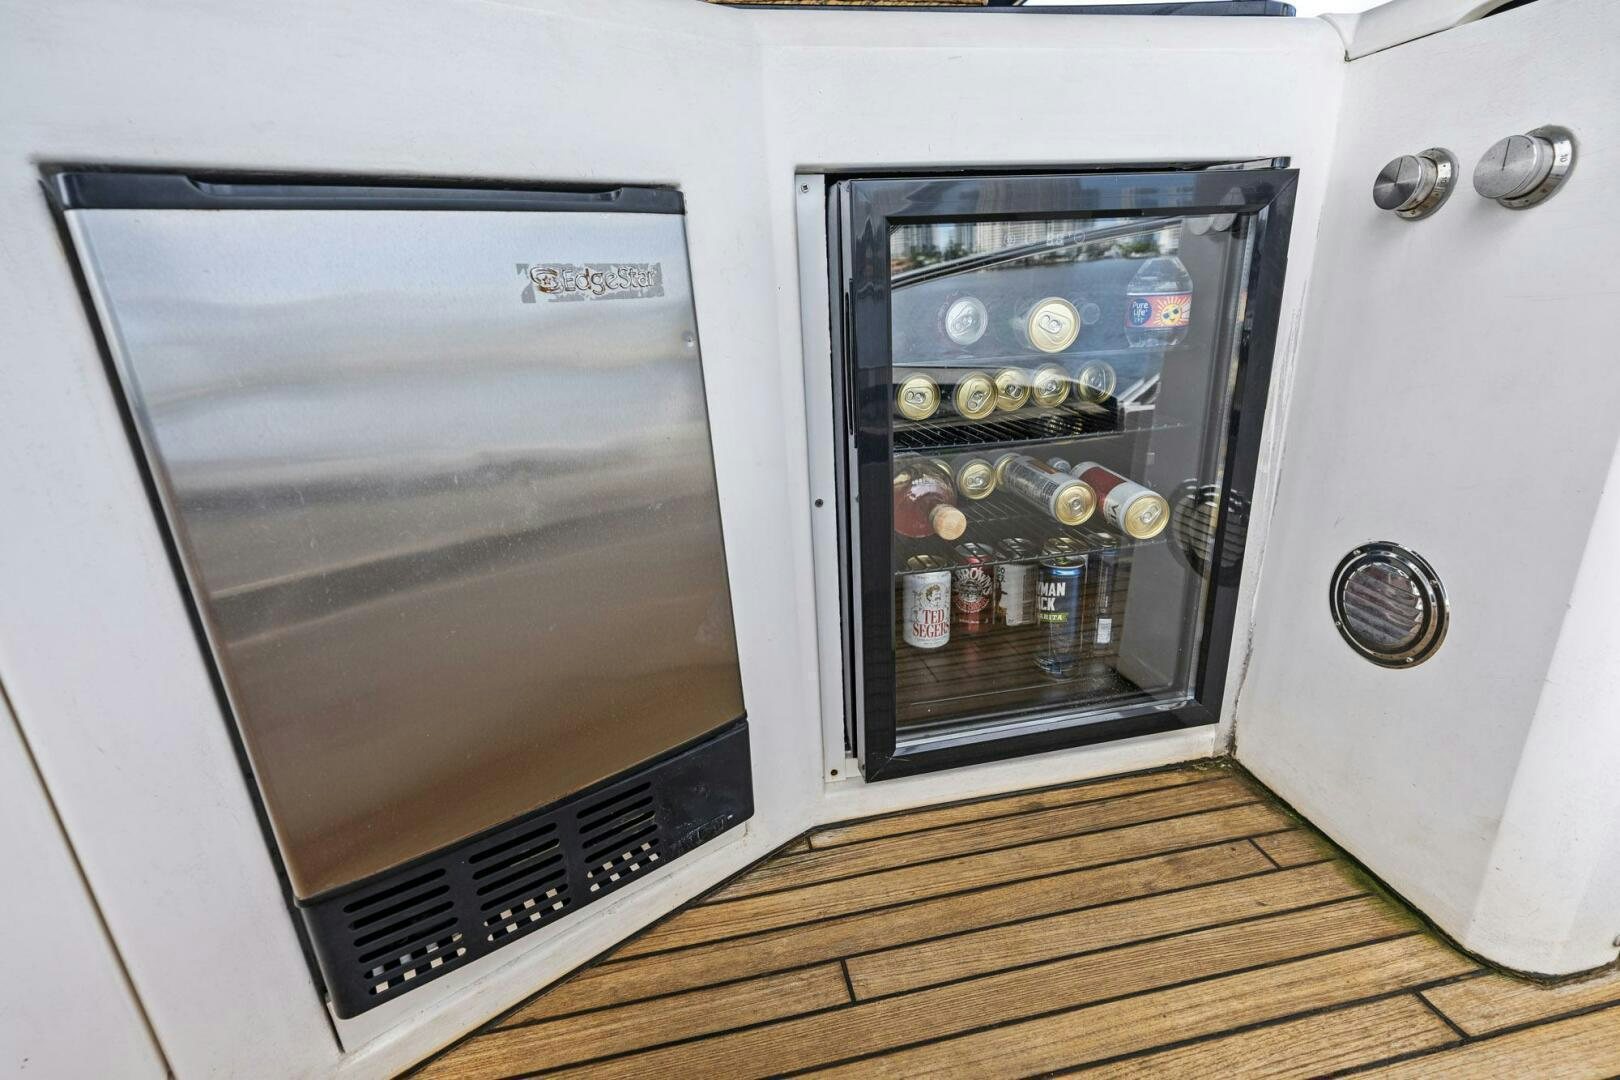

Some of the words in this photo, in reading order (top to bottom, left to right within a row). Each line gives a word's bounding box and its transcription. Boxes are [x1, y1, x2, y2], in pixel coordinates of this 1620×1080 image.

[561, 266, 656, 296] EdgeStar
[1132, 301, 1149, 309] Pure
[1038, 597, 1056, 611] CK
[922, 609, 945, 624] TED
